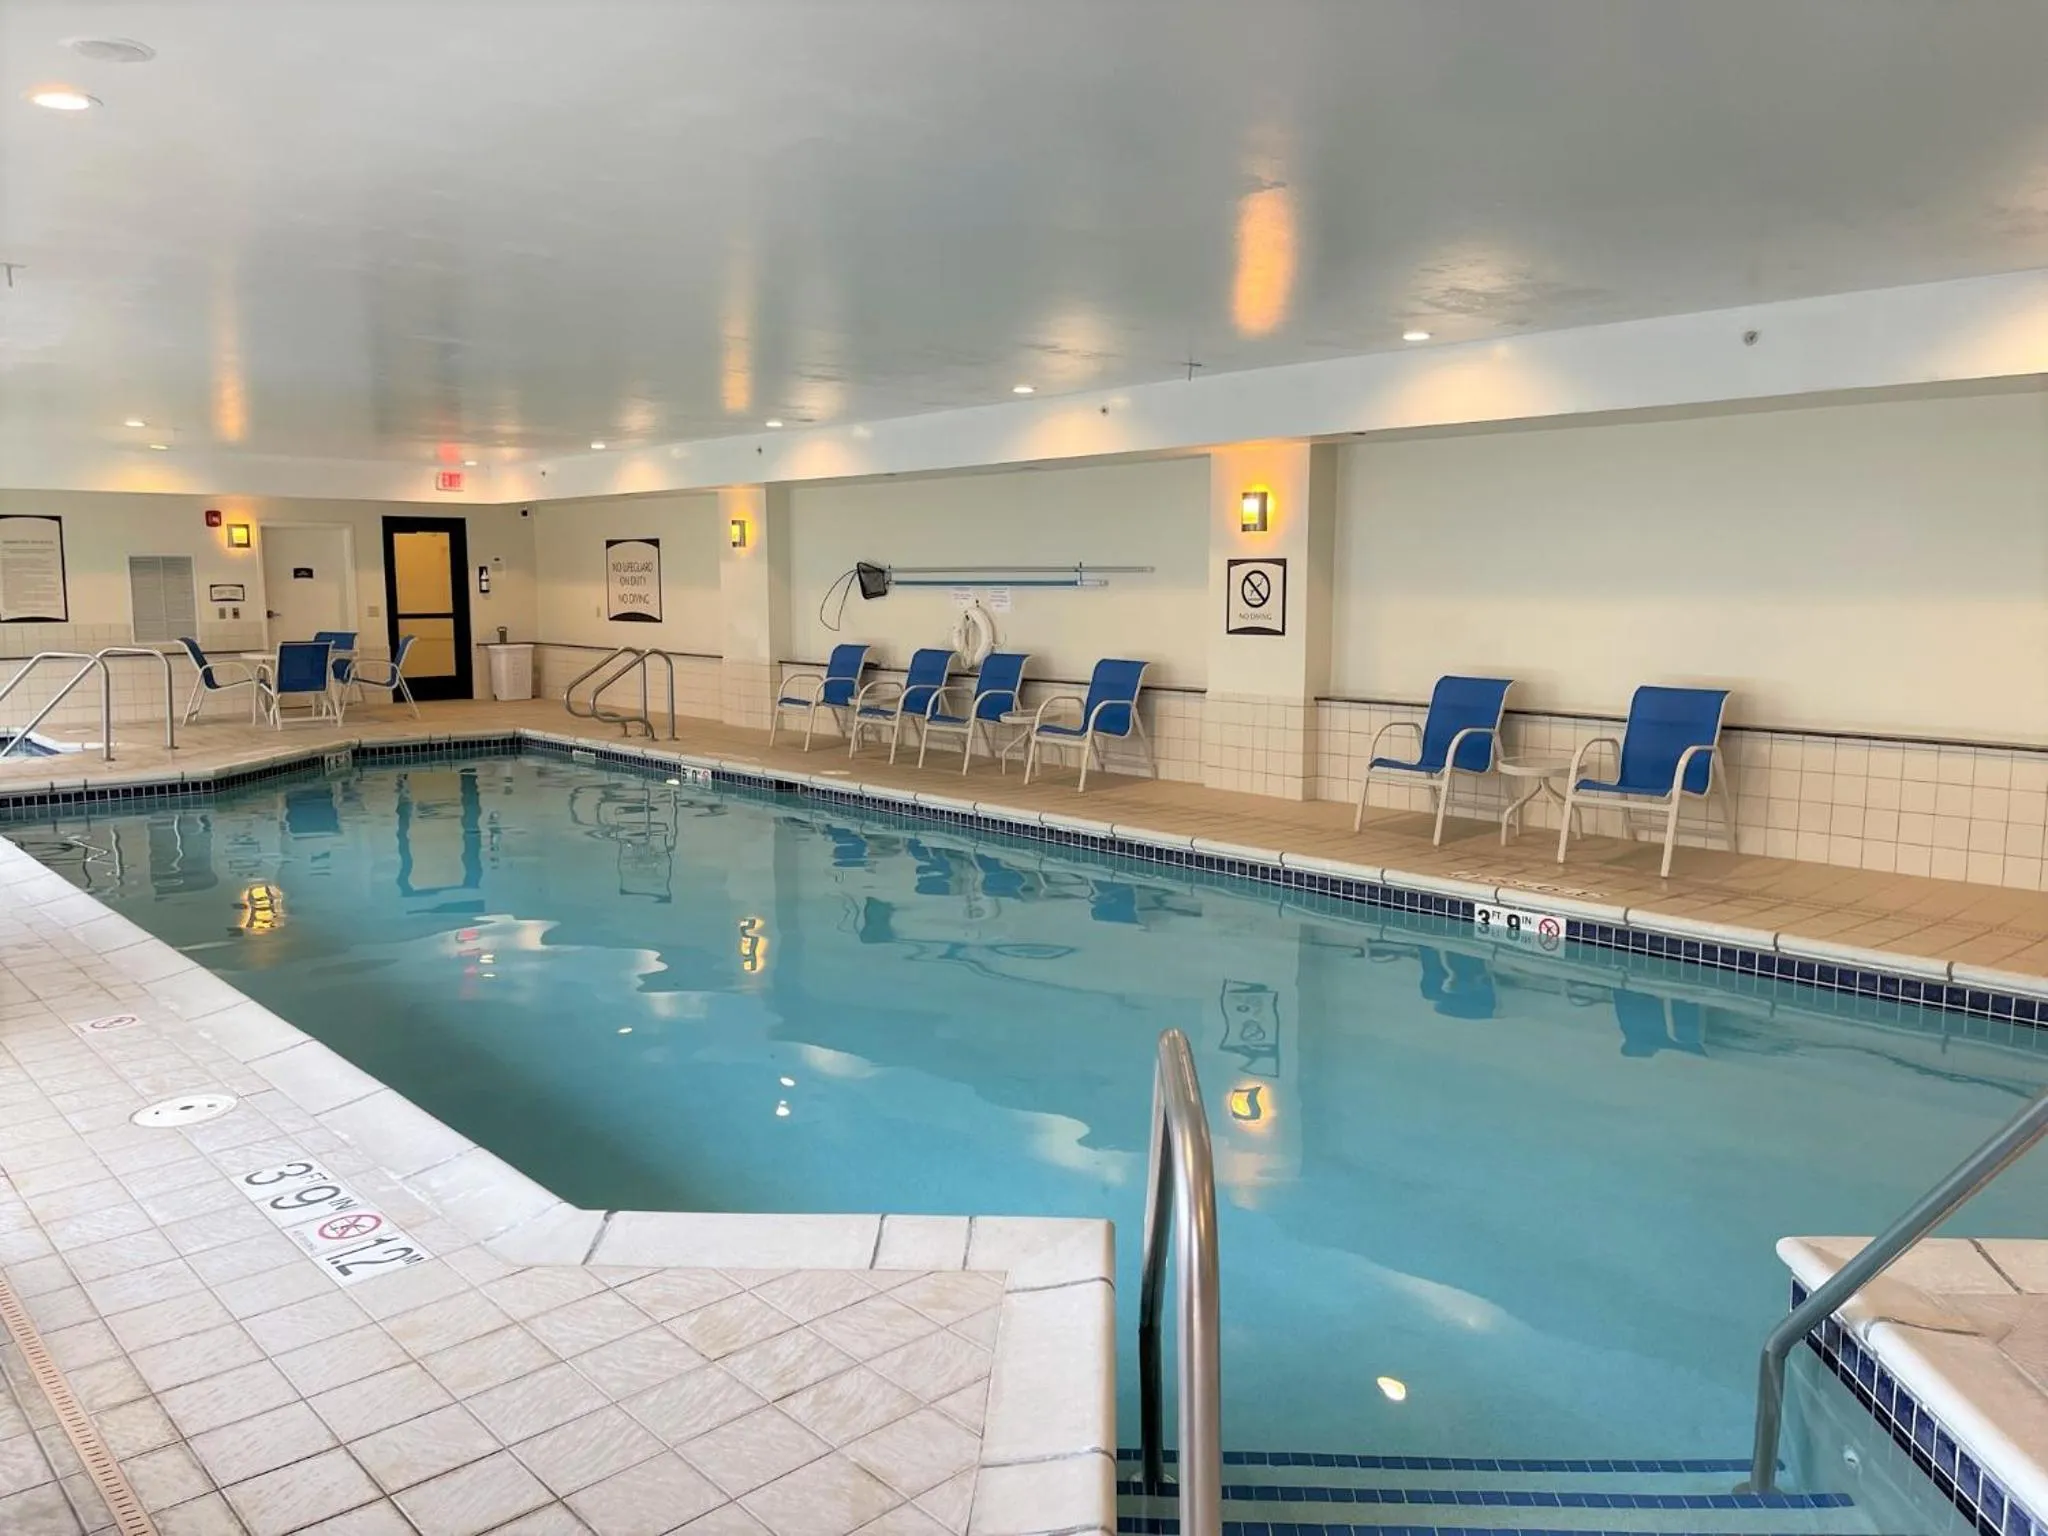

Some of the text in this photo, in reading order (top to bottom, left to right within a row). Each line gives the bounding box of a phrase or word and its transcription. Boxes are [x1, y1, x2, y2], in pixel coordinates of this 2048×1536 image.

[1239, 613, 1250, 621] NO
[1478, 909, 1490, 925] 3
[1507, 914, 1521, 931] 9
